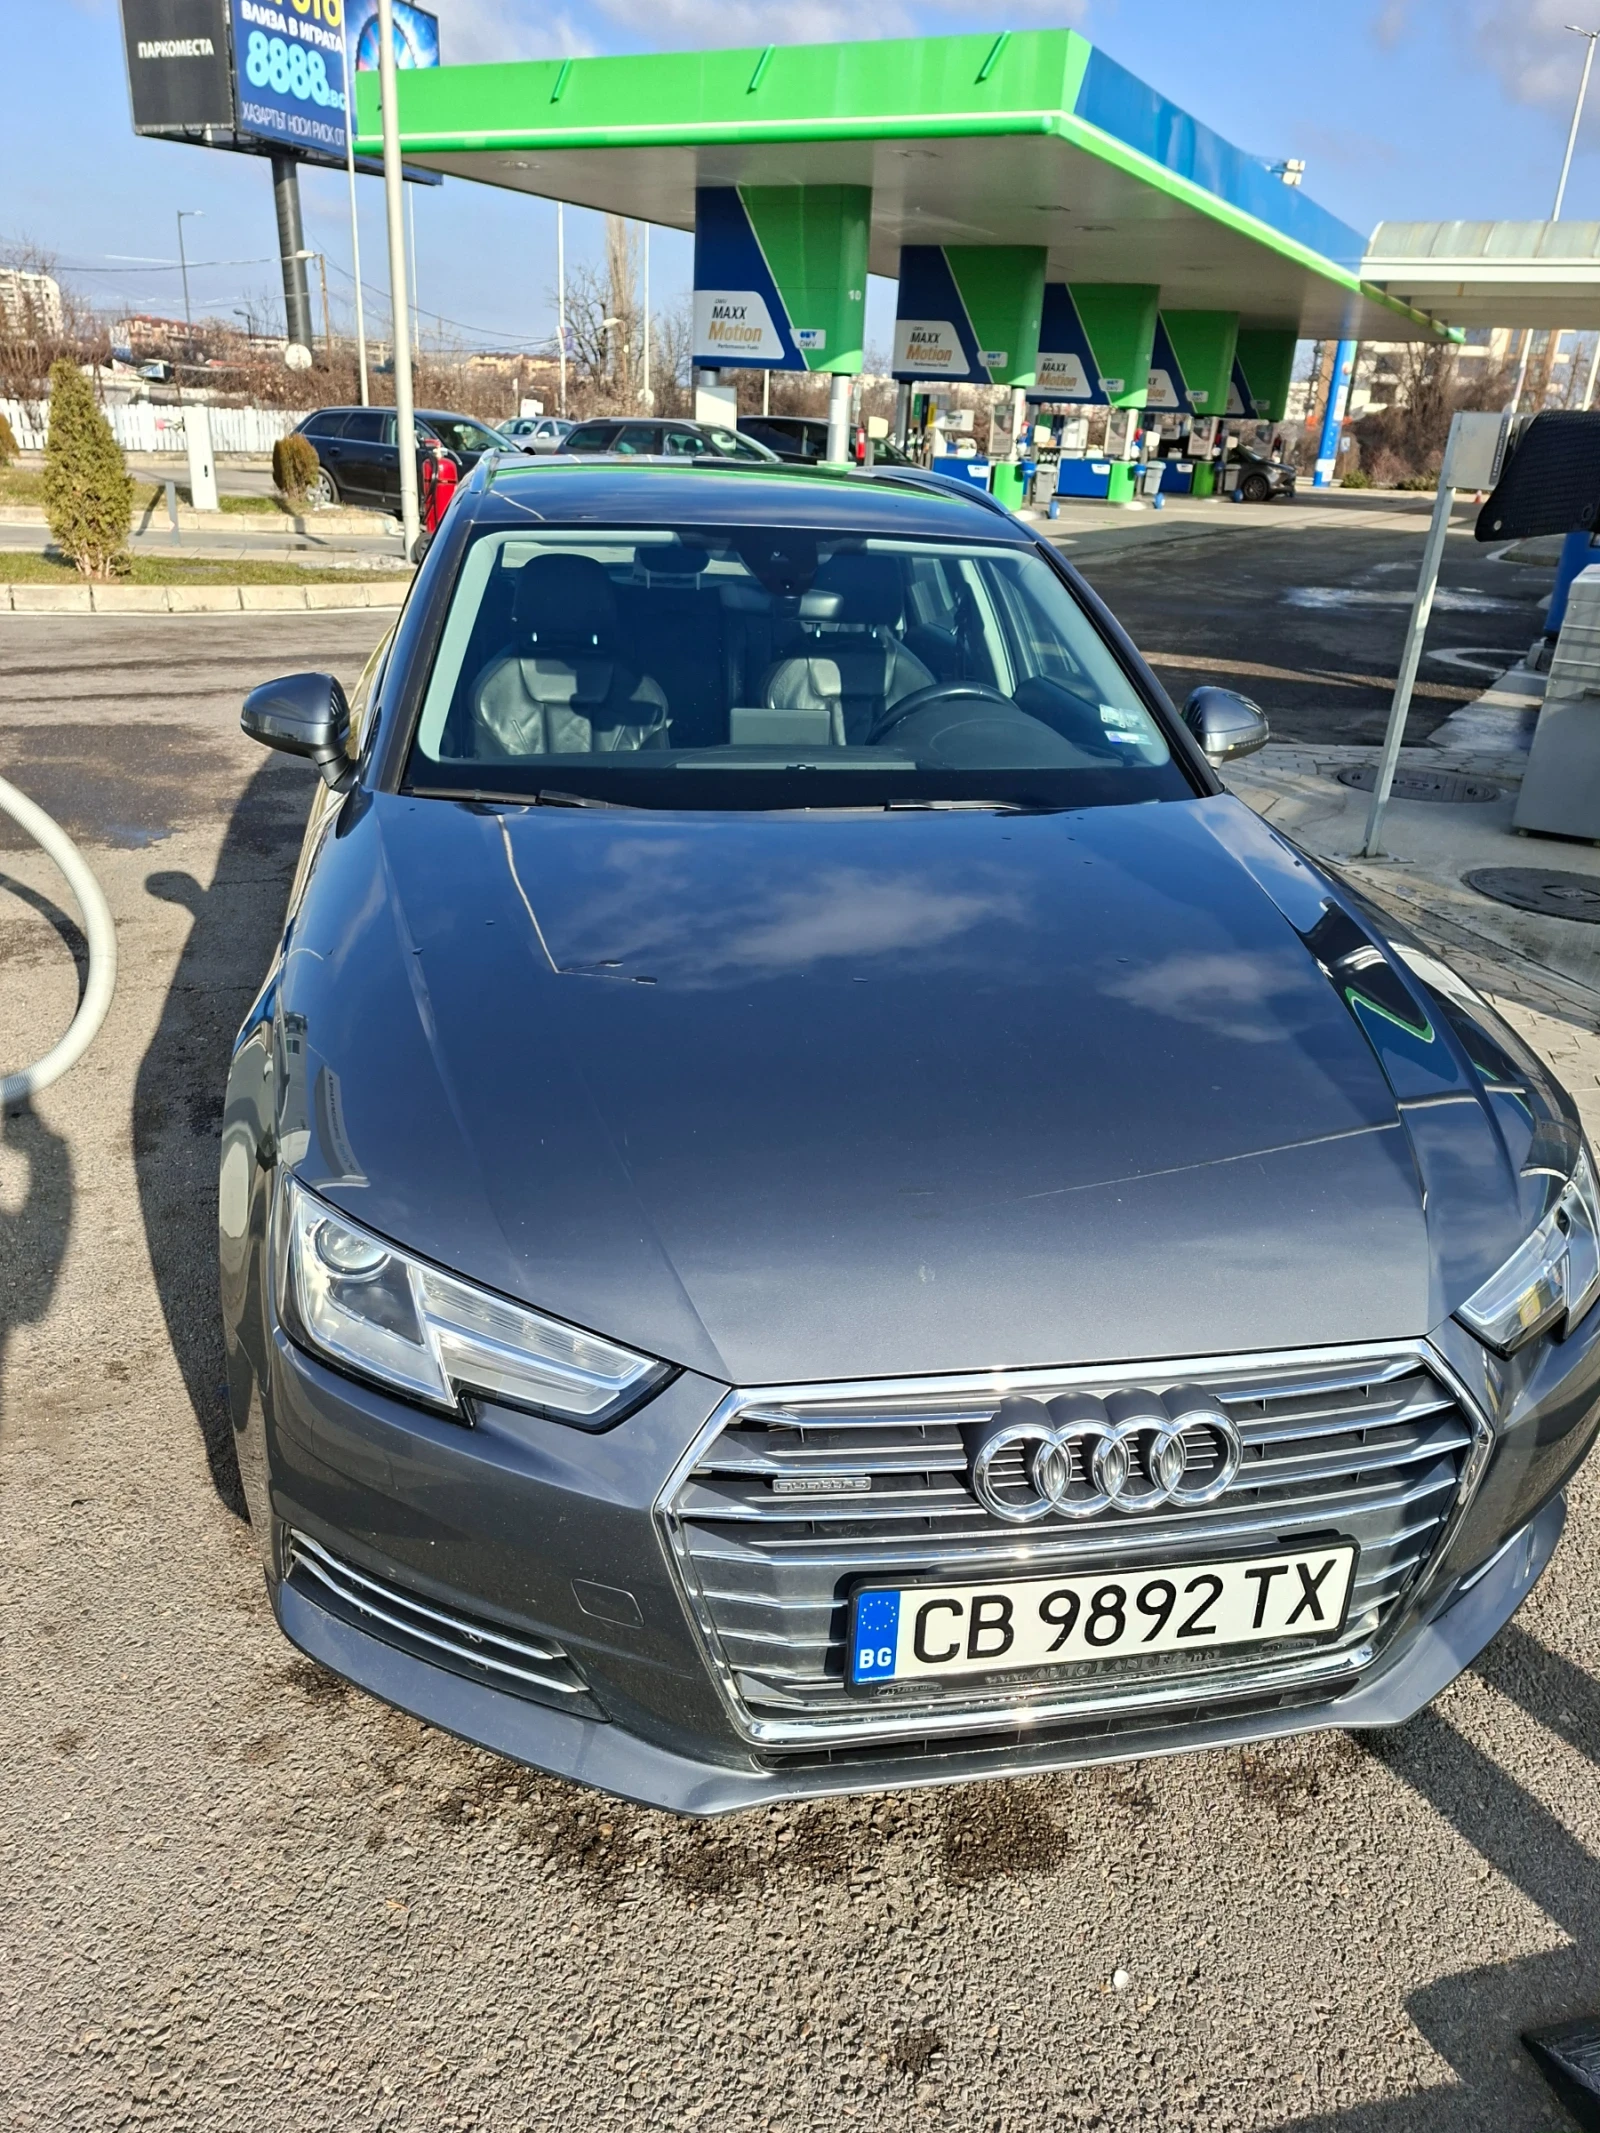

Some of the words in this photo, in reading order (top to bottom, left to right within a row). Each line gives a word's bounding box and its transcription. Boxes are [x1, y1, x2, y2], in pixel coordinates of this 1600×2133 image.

[241, 0, 287, 33] ВЛИЗА
[288, 16, 298, 37] В
[299, 20, 344, 53] ИГРАТА
[138, 38, 214, 58] ПАРКОМЕСТА
[287, 114, 312, 137] НОСИ
[312, 121, 334, 144] РИСК
[334, 128, 345, 146] ОТ
[711, 305, 748, 320] MAXX
[708, 320, 762, 342] Motion
[910, 332, 941, 344] MAXX
[906, 344, 953, 362] Motion
[1041, 362, 1068, 372] MAXX
[913, 1594, 1015, 1664] CB
[1038, 1574, 1223, 1653] 9892
[1244, 1558, 1338, 1629] TX
[859, 1647, 892, 1669] BG
